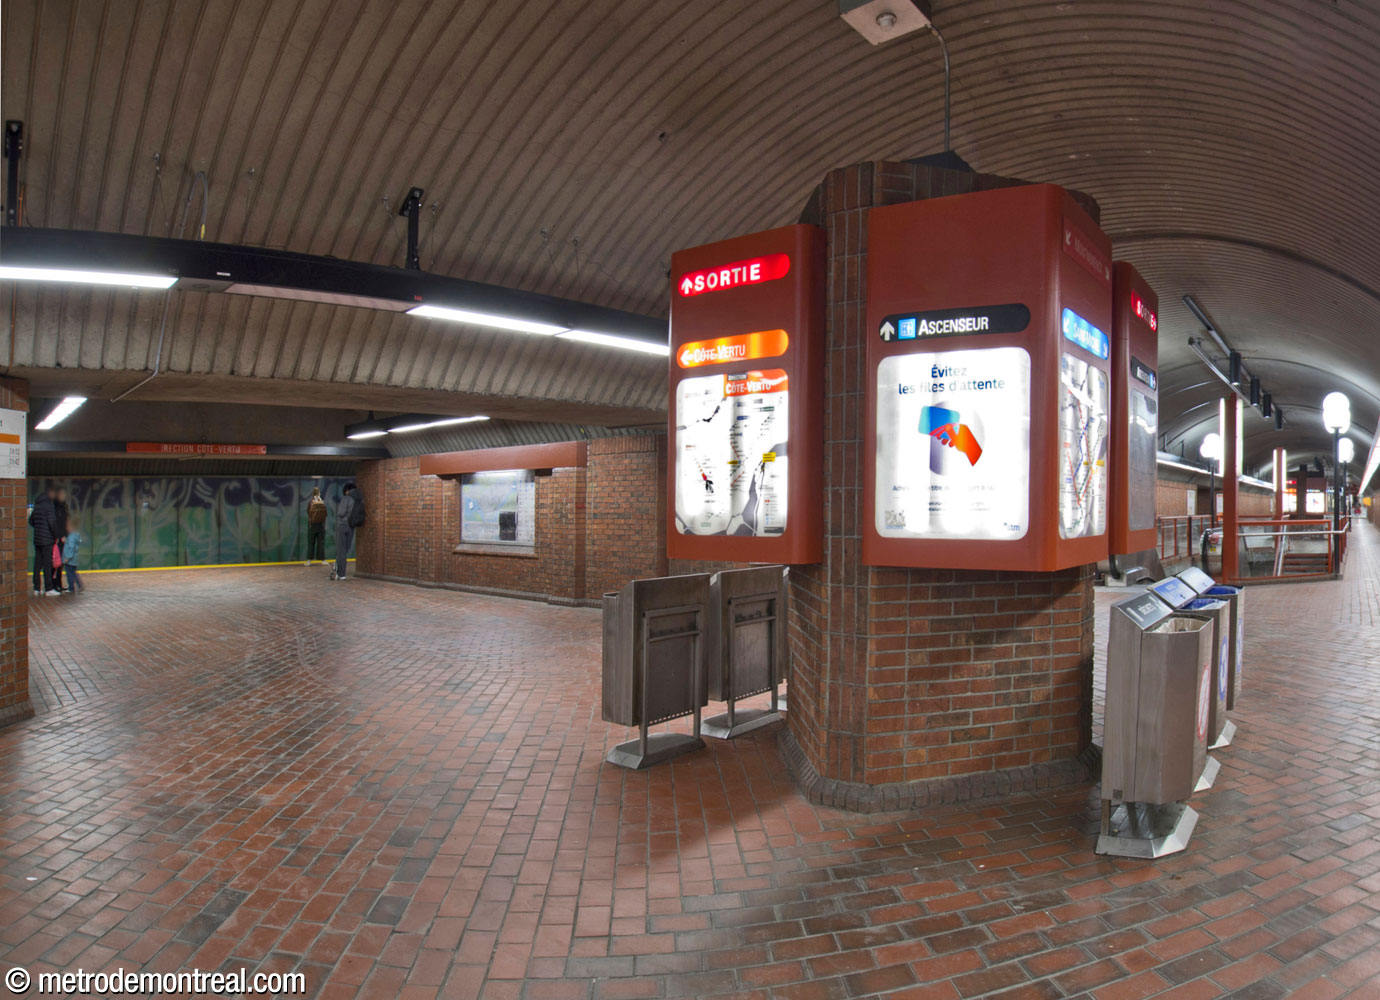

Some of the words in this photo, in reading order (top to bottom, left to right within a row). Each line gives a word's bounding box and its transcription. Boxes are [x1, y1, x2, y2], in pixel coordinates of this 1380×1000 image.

[694, 263, 761, 292] SORTIE
[918, 316, 989, 336] ASCENSEUR
[931, 364, 967, 379] Évitez
[898, 383, 916, 395] les
[919, 381, 945, 393] files
[949, 378, 1005, 392] d'attente
